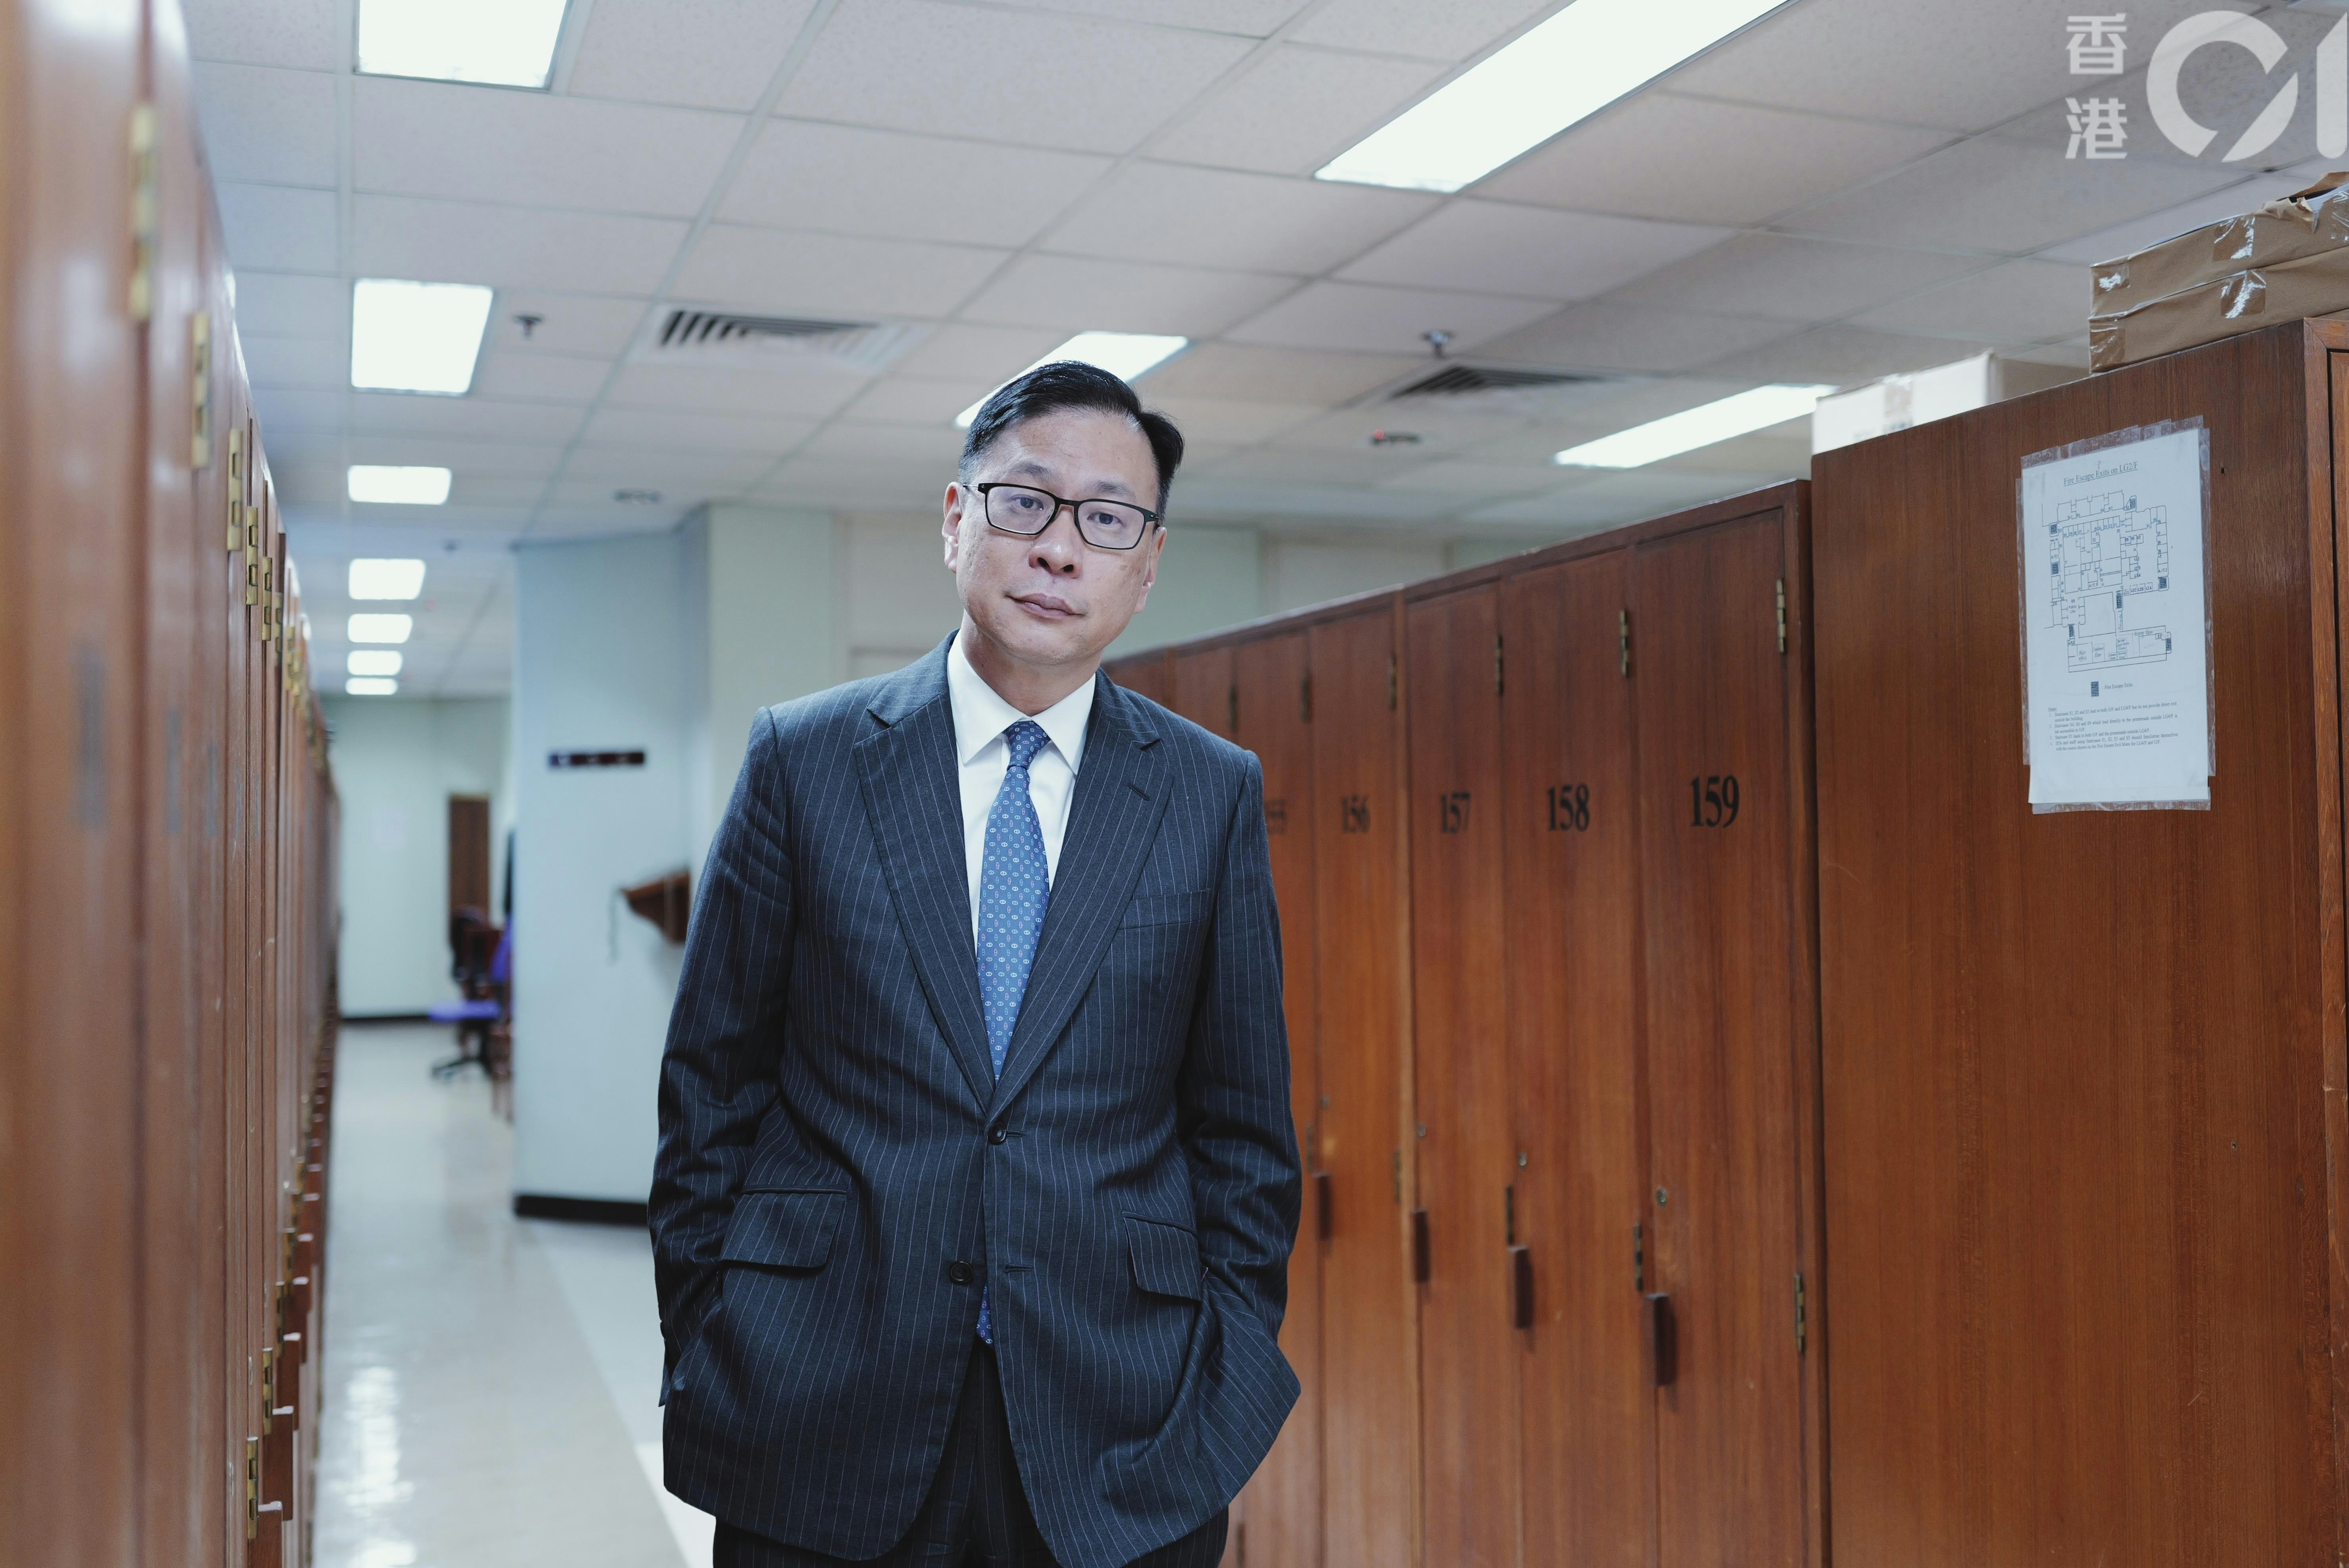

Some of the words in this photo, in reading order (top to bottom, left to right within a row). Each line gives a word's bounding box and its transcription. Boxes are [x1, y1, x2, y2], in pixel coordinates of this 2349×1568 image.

[2095, 469, 2109, 478] Exits
[2119, 461, 2138, 472] LG2/F
[1340, 794, 1370, 833] 156
[1440, 792, 1471, 834] 157
[1547, 783, 1590, 832] 158
[1690, 775, 1740, 828] 159
